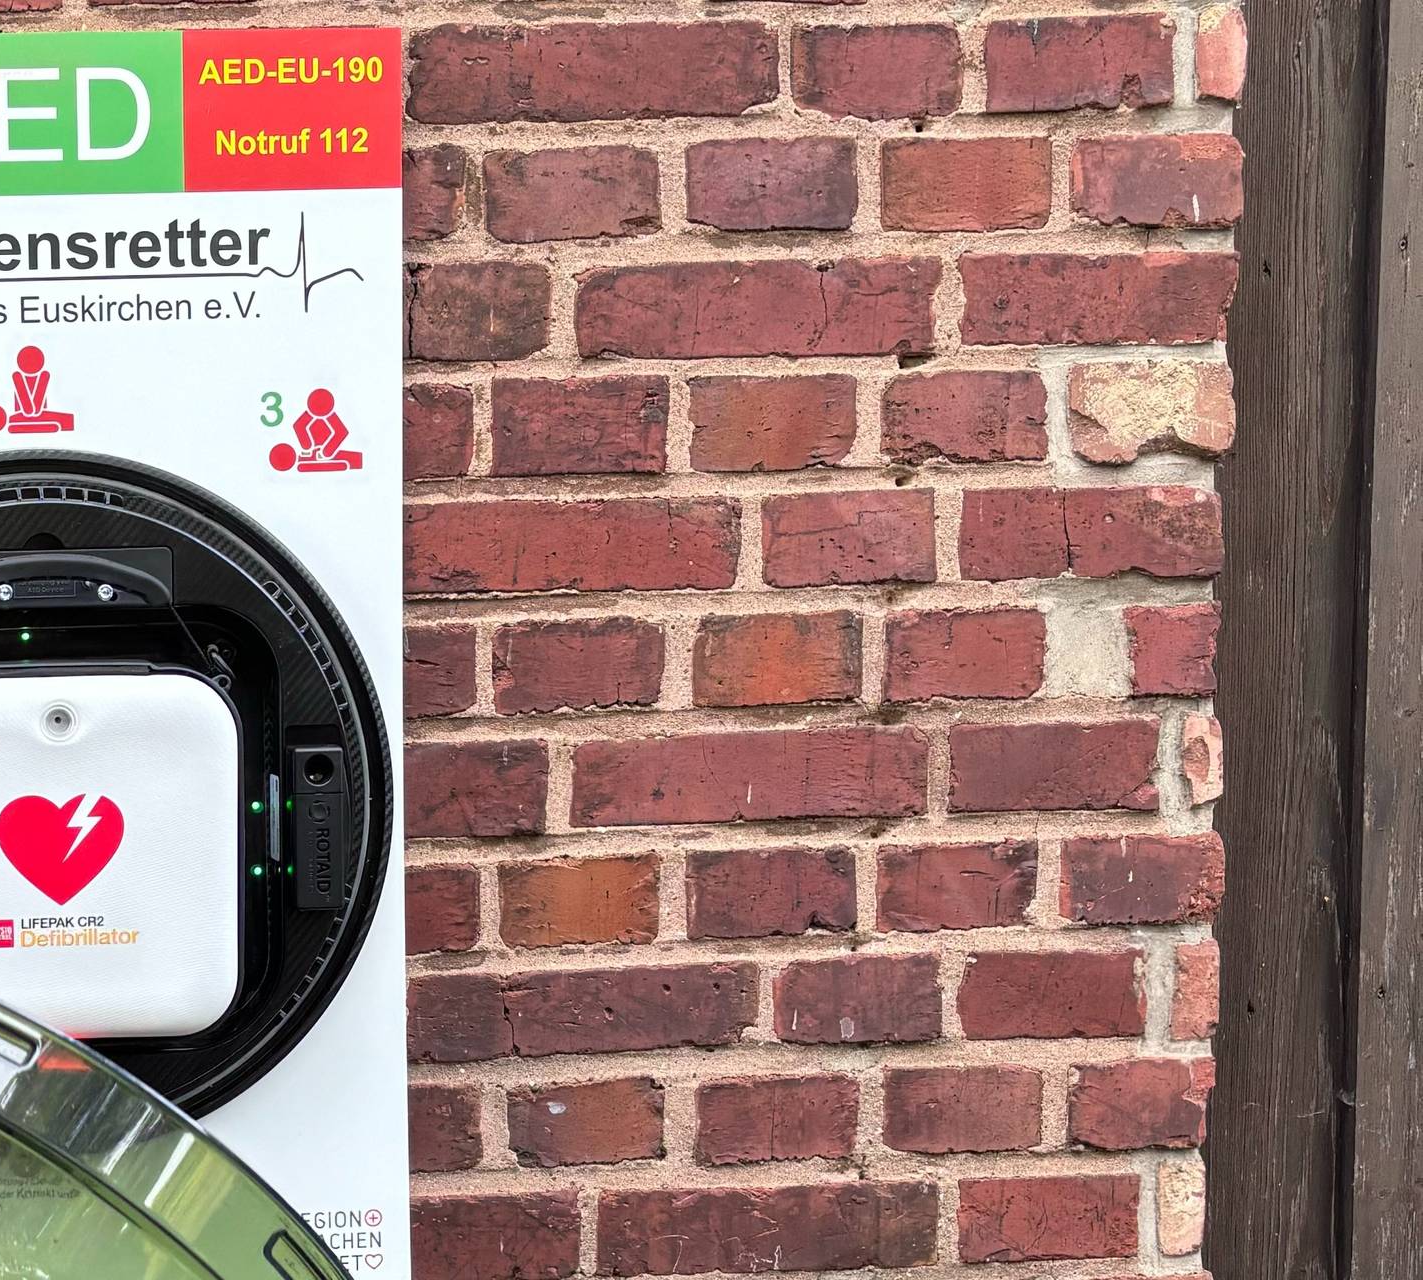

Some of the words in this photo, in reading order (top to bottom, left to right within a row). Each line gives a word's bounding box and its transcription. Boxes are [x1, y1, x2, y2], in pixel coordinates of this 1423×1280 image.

[199, 56, 383, 84] AED-EU-190
[216, 127, 311, 156] Notruf
[320, 127, 369, 154] 112
[20, 293, 192, 324] Euskirchen
[204, 290, 261, 320] e.V.
[259, 392, 285, 428] 3
[316, 828, 331, 895] ROTAID
[21, 917, 74, 930] LIFEPAK
[77, 915, 104, 928] CR2
[20, 927, 139, 948] Defibrillator
[300, 1210, 362, 1229] EGION
[320, 1231, 382, 1250] CHEN
